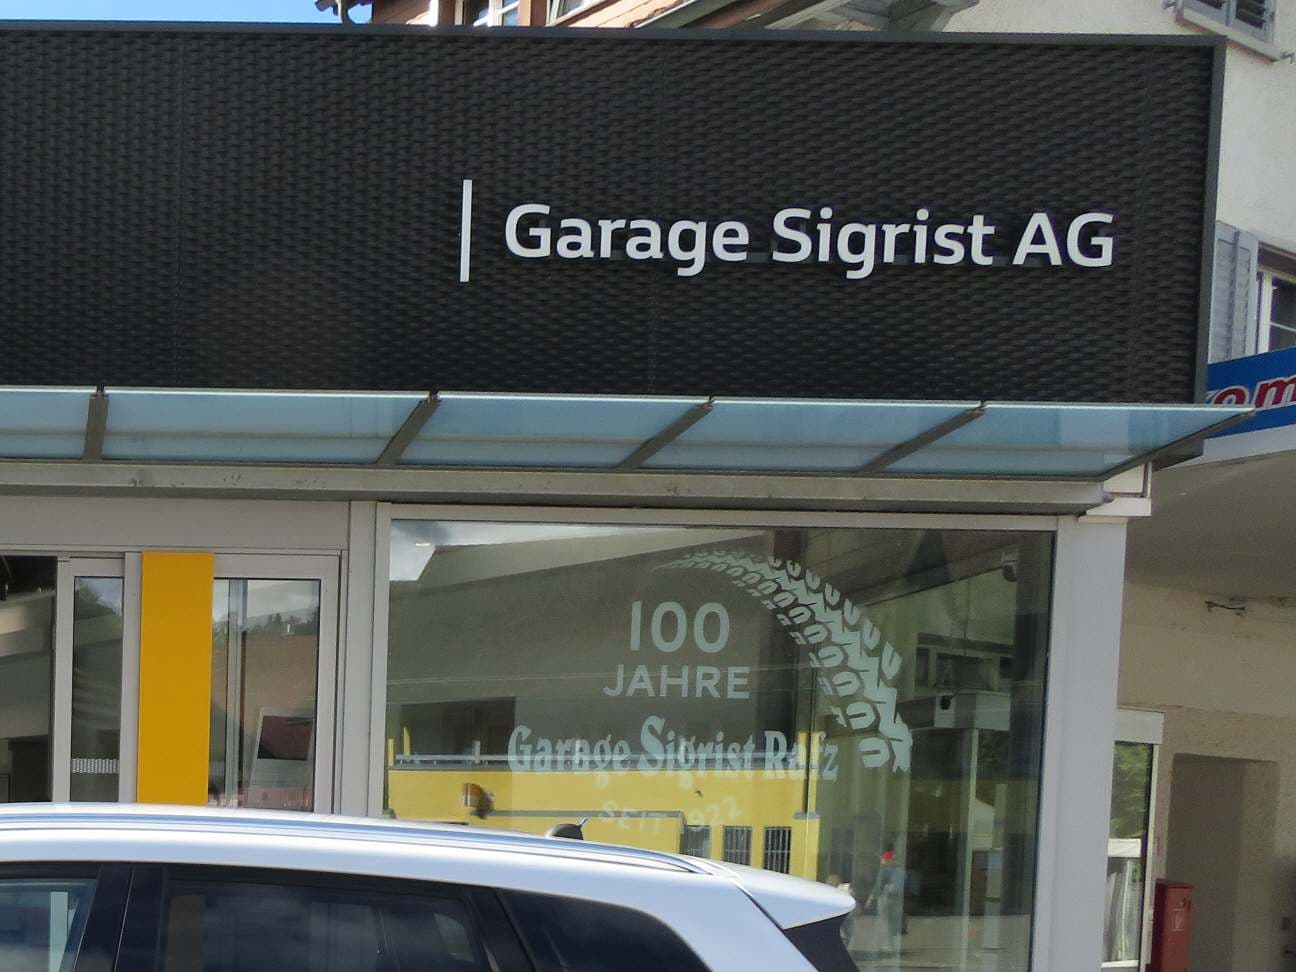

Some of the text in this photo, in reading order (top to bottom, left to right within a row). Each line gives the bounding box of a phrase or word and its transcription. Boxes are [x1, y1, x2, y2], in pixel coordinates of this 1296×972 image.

[505, 203, 1115, 280] Garage Sigrist AG
[630, 600, 731, 653] 100
[603, 664, 751, 700] JAHRE
[508, 724, 632, 788] Garage
[636, 715, 756, 790] Sigrist
[680, 795, 742, 832] 922
